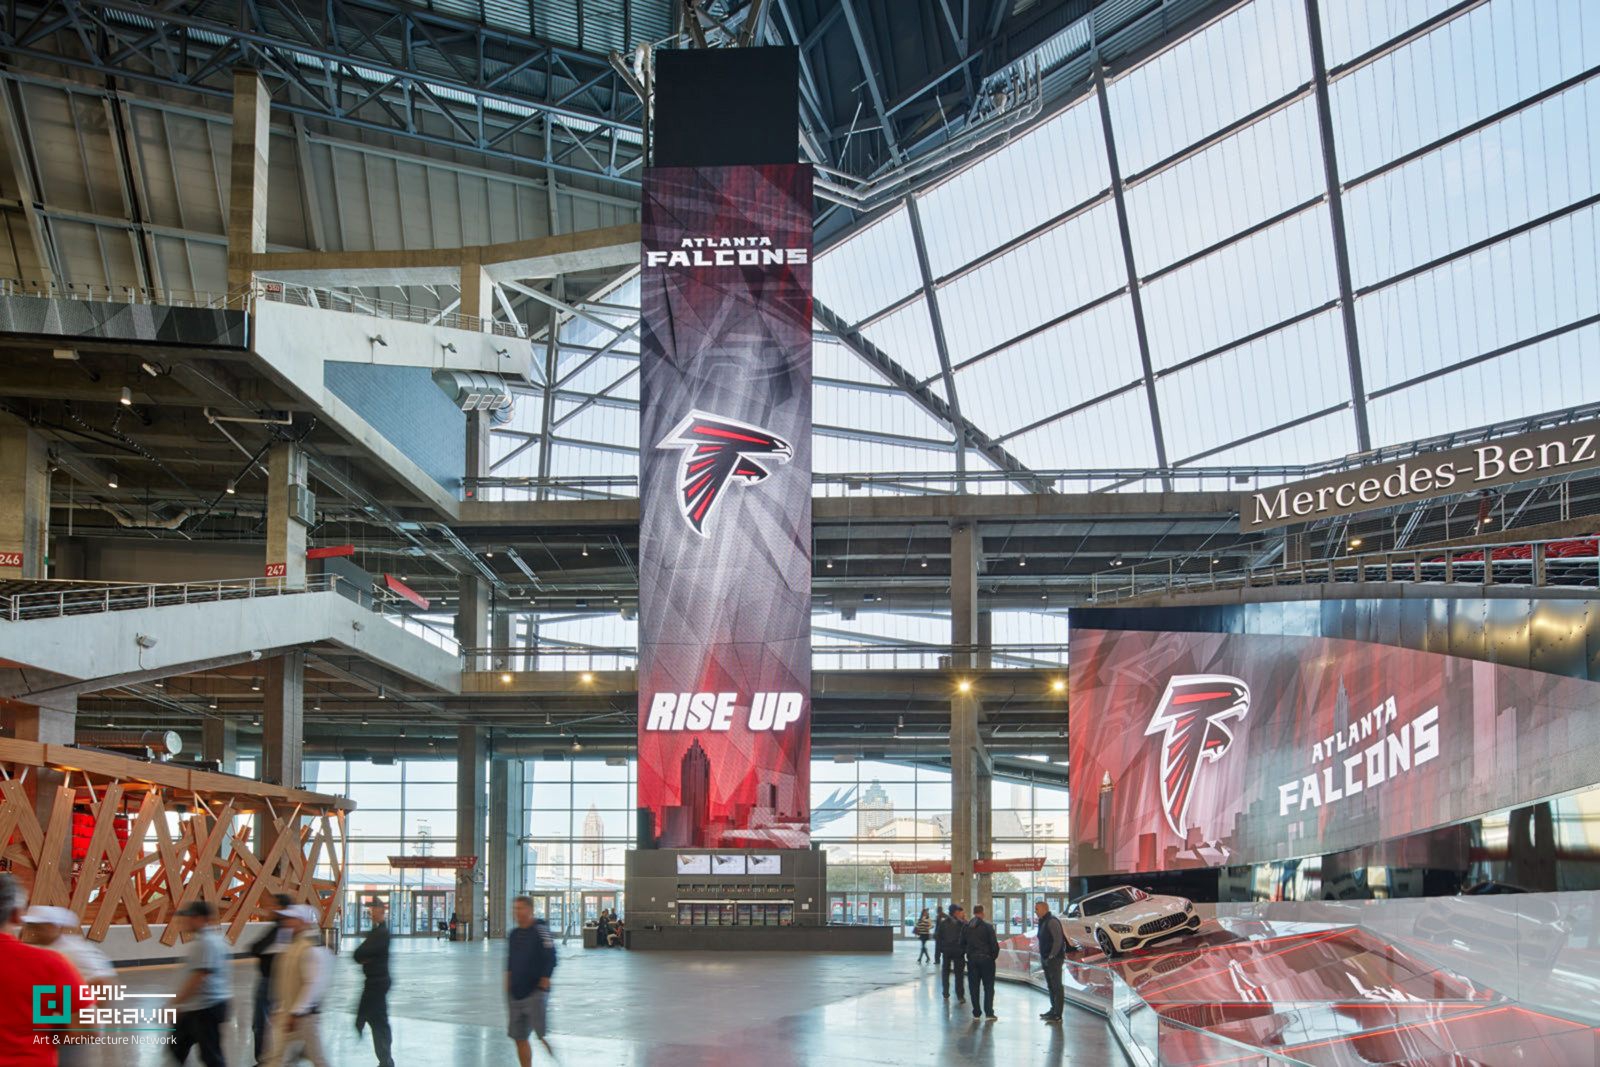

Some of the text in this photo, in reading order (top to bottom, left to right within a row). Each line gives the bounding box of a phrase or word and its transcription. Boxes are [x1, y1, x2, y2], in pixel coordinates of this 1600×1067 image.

[681, 236, 772, 248] ATLANTA
[646, 248, 808, 267] FALCONS
[1251, 434, 1596, 525] Mercedes-Benz
[0, 554, 20, 565] 246
[267, 565, 284, 576] 247
[646, 692, 804, 731] RISE UP
[1312, 695, 1397, 764] ATLANTA
[1278, 705, 1440, 816] FALCONS
